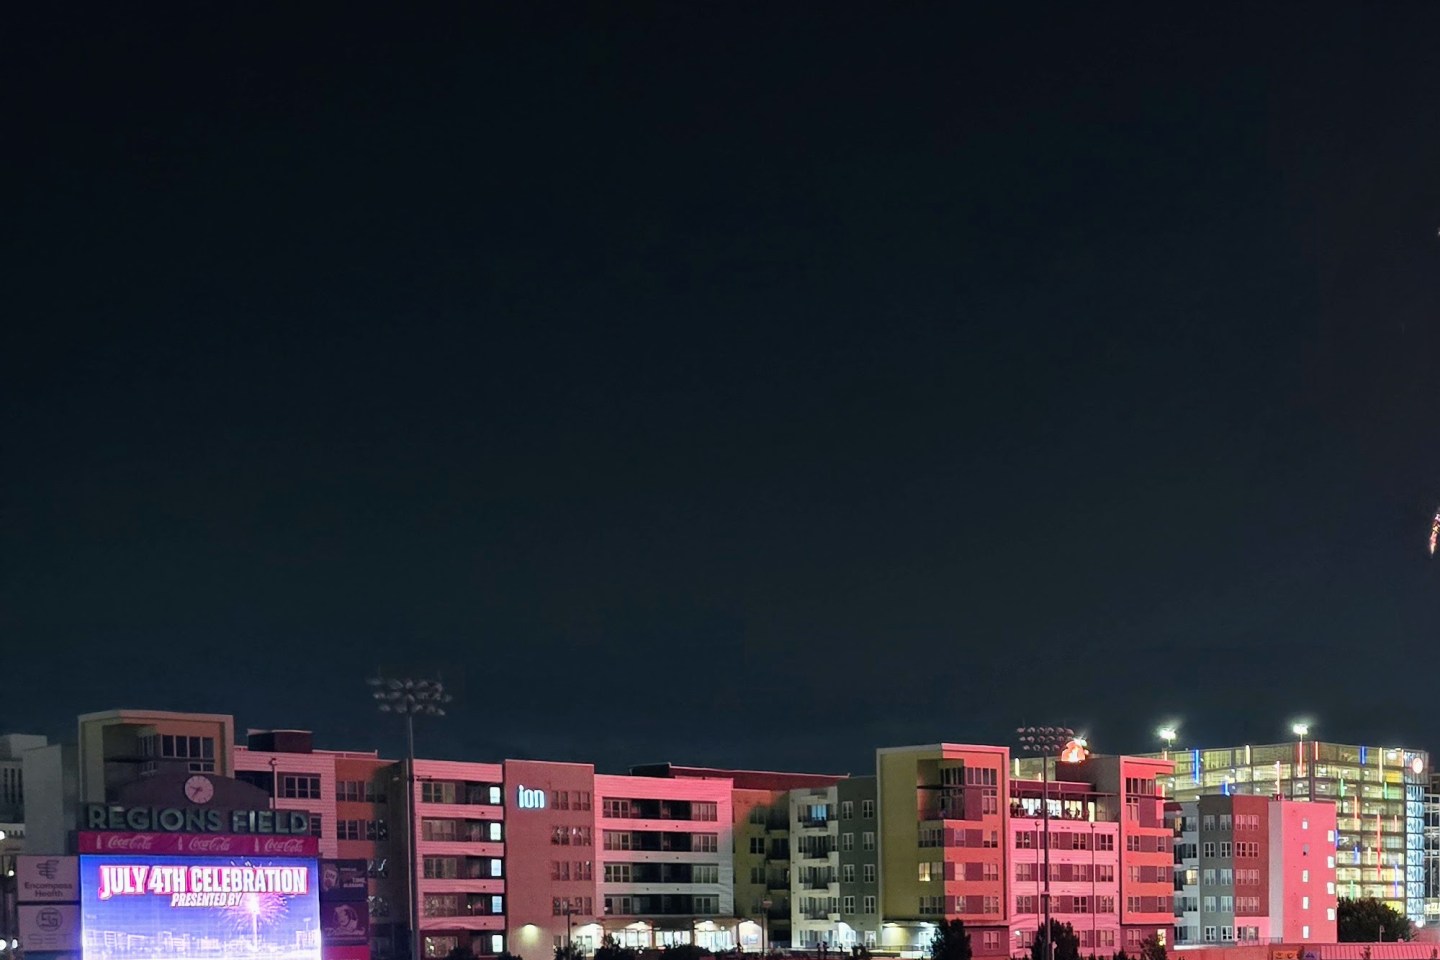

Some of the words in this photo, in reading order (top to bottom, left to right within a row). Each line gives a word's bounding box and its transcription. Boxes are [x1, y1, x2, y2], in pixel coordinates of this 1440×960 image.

[519, 784, 544, 808] ion
[88, 805, 221, 831] REGIONS
[232, 810, 308, 834] FIELD
[24, 882, 73, 890] Encompass
[99, 866, 149, 898] JULY
[149, 866, 188, 893] 4TH
[190, 867, 307, 894] CELEBRATION
[171, 893, 226, 907] PRESENTED
[227, 893, 243, 906] BY
